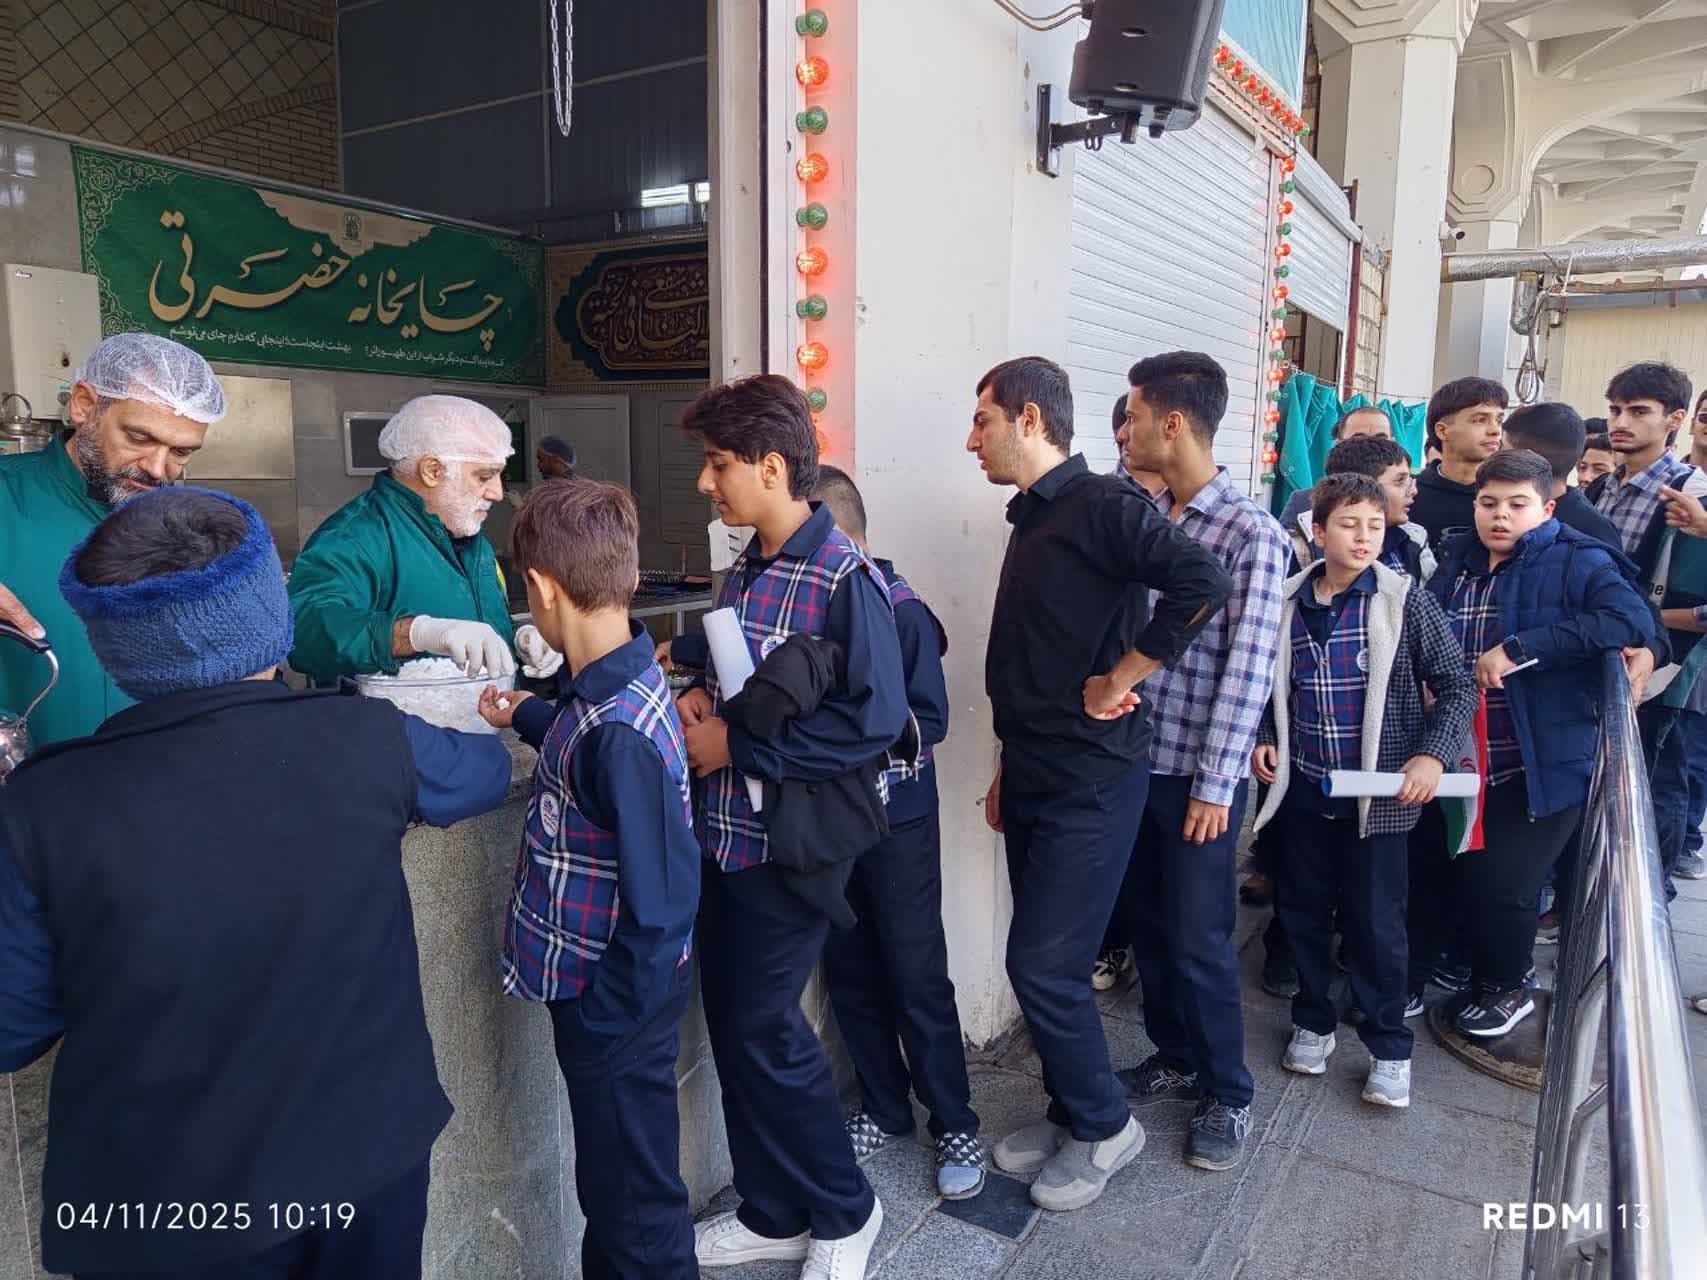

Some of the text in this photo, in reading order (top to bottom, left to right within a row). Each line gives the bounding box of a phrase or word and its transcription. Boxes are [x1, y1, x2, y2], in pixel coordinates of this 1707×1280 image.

[148, 209, 352, 323] حضرتی
[347, 269, 505, 353] چایخانه
[206, 328, 228, 343] چای
[227, 331, 245, 345] دارم
[244, 331, 257, 343] که
[325, 337, 353, 354] بهشت
